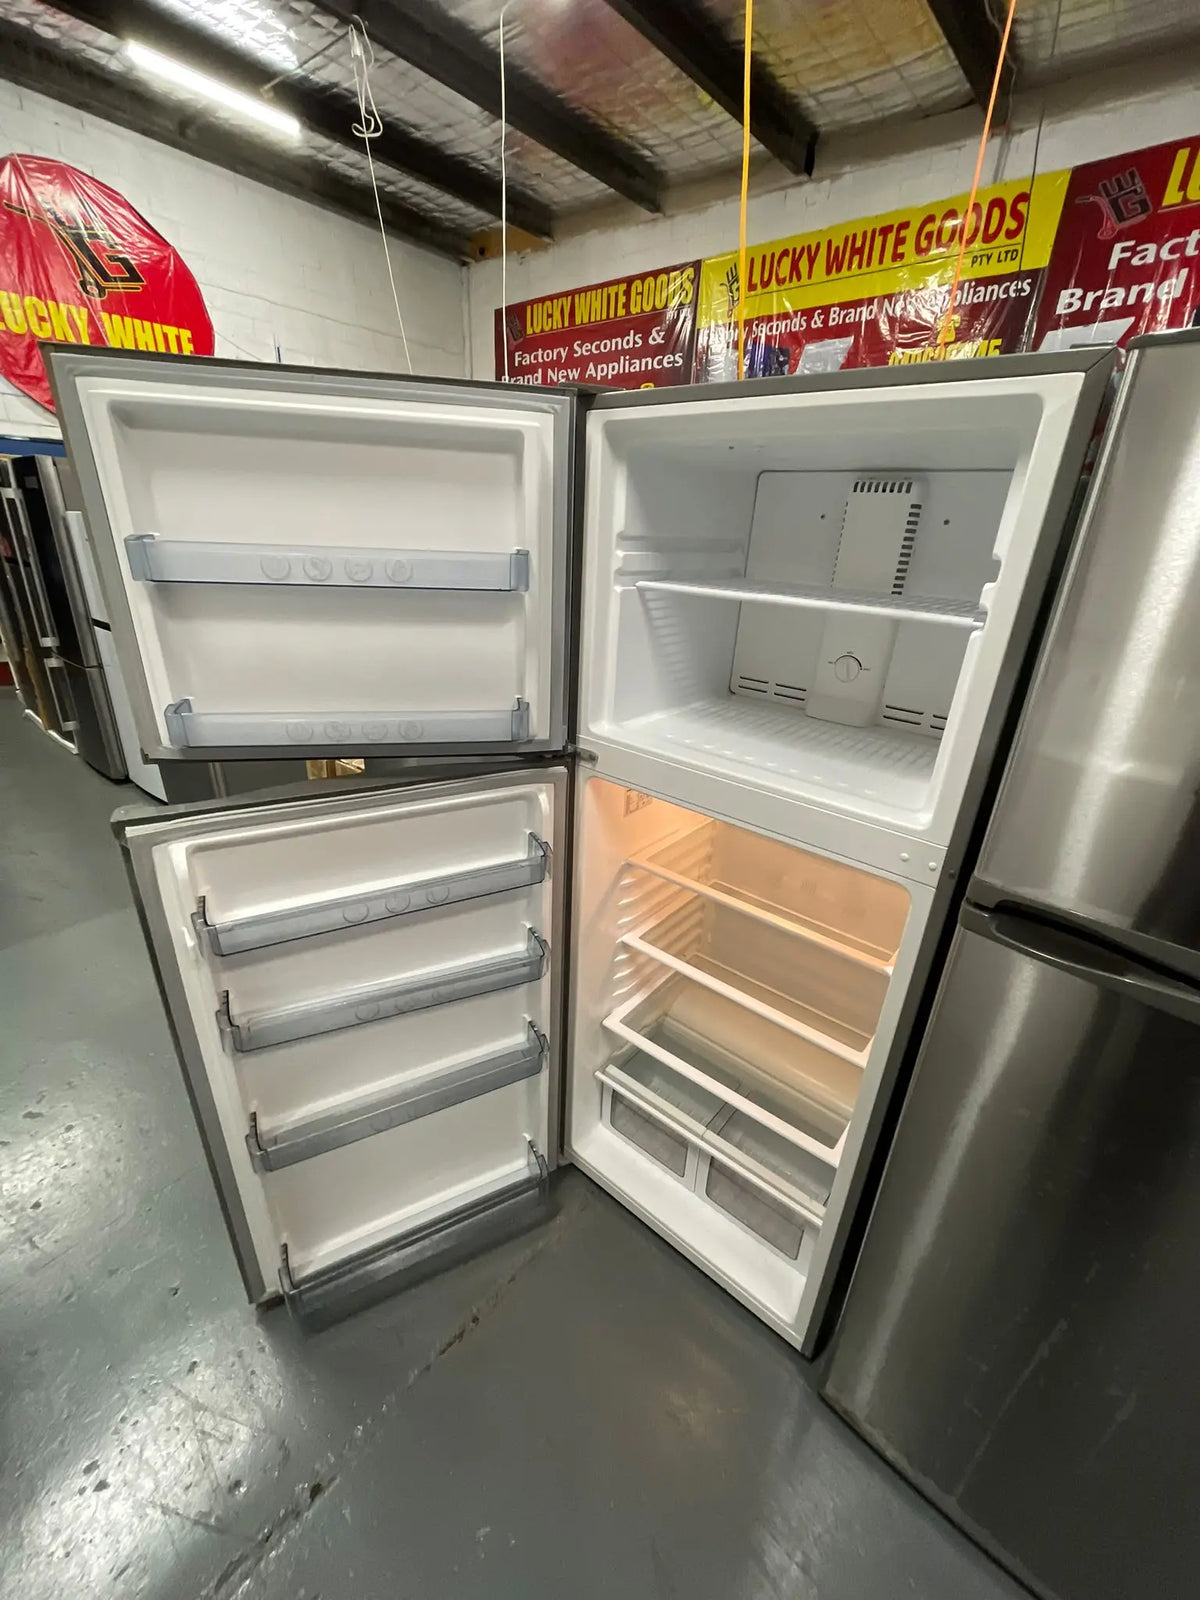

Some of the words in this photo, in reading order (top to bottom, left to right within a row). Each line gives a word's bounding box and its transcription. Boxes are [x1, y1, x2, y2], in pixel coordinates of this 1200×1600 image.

[747, 241, 821, 292] LUCKY
[825, 220, 910, 276] WHITE
[914, 192, 1029, 256] GOODS
[970, 252, 993, 268] PTY
[996, 248, 1019, 263] LTD
[526, 296, 572, 335] LUCKY
[574, 283, 626, 326] WHITE
[630, 267, 694, 315] GOODS
[1056, 268, 1189, 315] Brand
[810, 309, 824, 329] &
[828, 298, 877, 327] Brand
[515, 346, 568, 367] Factory
[573, 331, 643, 357] Seconds
[648, 326, 665, 345] &
[585, 352, 683, 380] Appliances
